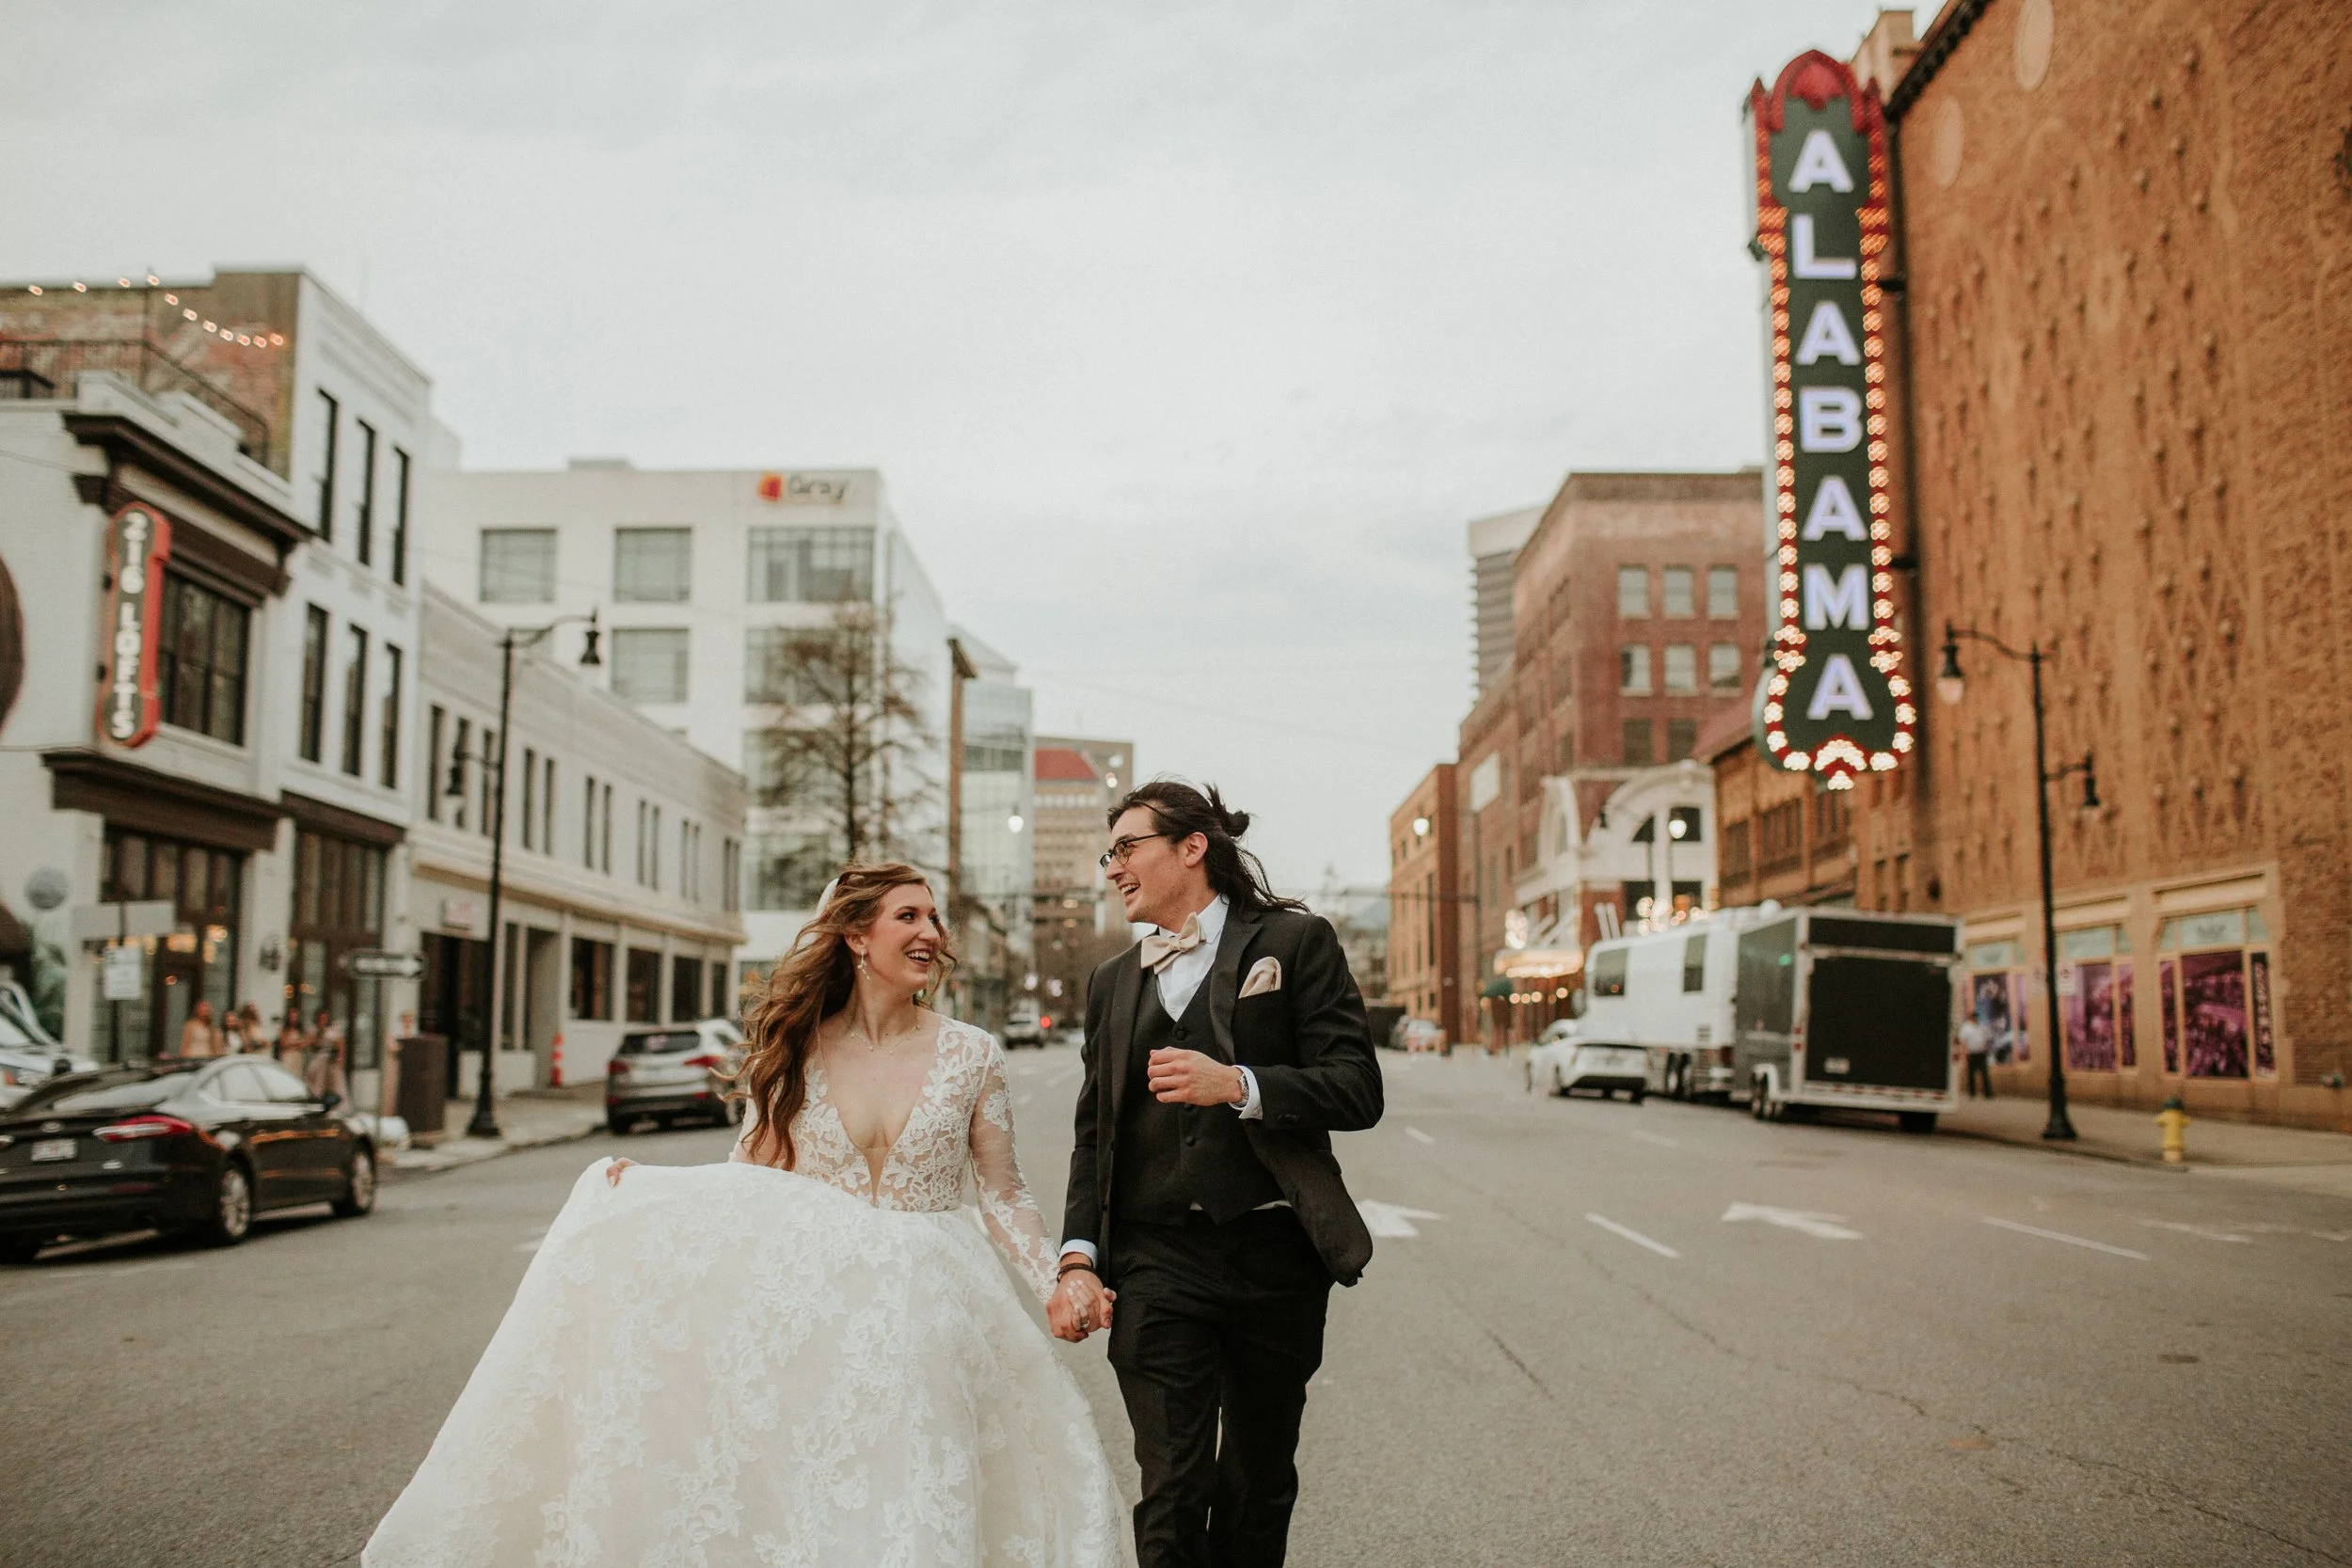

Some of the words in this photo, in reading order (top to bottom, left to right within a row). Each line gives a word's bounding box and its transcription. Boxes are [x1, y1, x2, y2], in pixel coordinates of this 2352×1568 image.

[787, 474, 850, 502] Gray
[1788, 130, 1874, 721] ALABAMA
[111, 601, 141, 739] LOFTS
